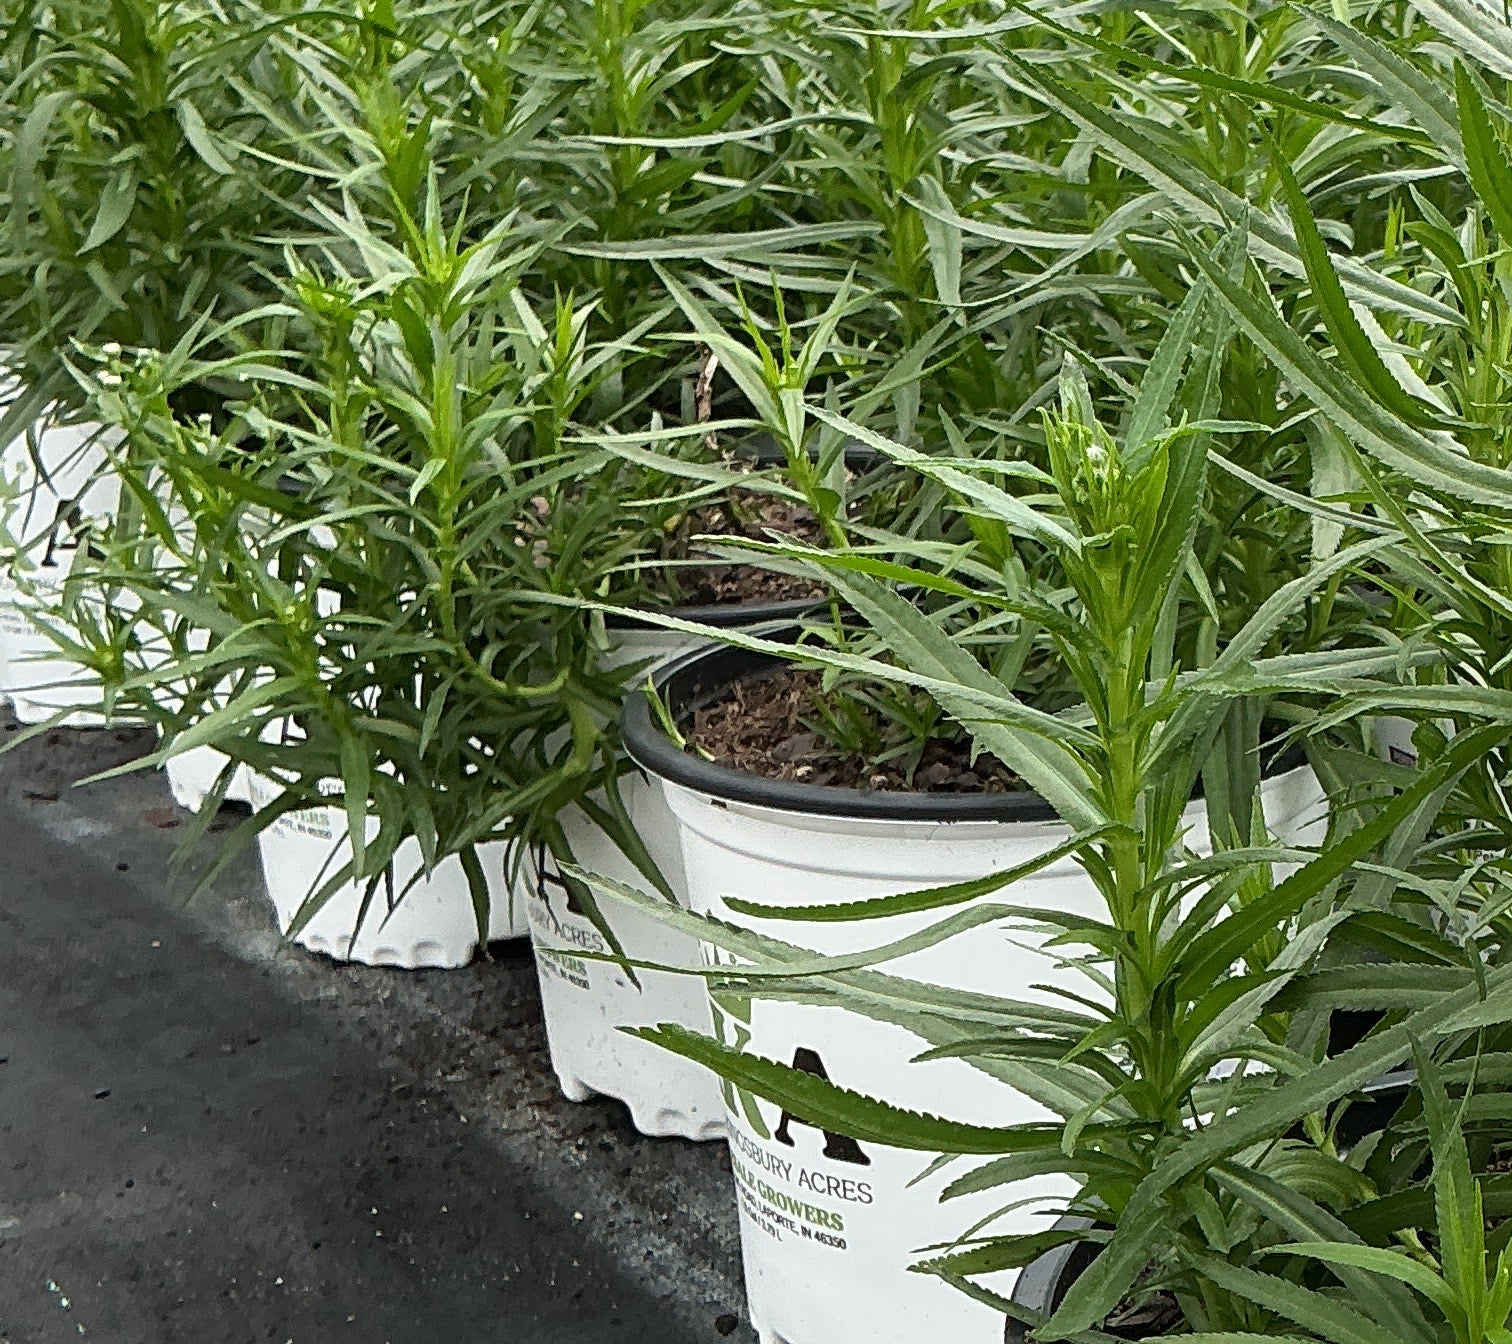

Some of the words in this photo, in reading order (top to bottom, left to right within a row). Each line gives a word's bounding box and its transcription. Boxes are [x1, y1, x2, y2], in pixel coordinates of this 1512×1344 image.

[798, 1167, 874, 1205] ACRES
[757, 1179, 845, 1232] GROWERS
[814, 1230, 848, 1251] 46350
